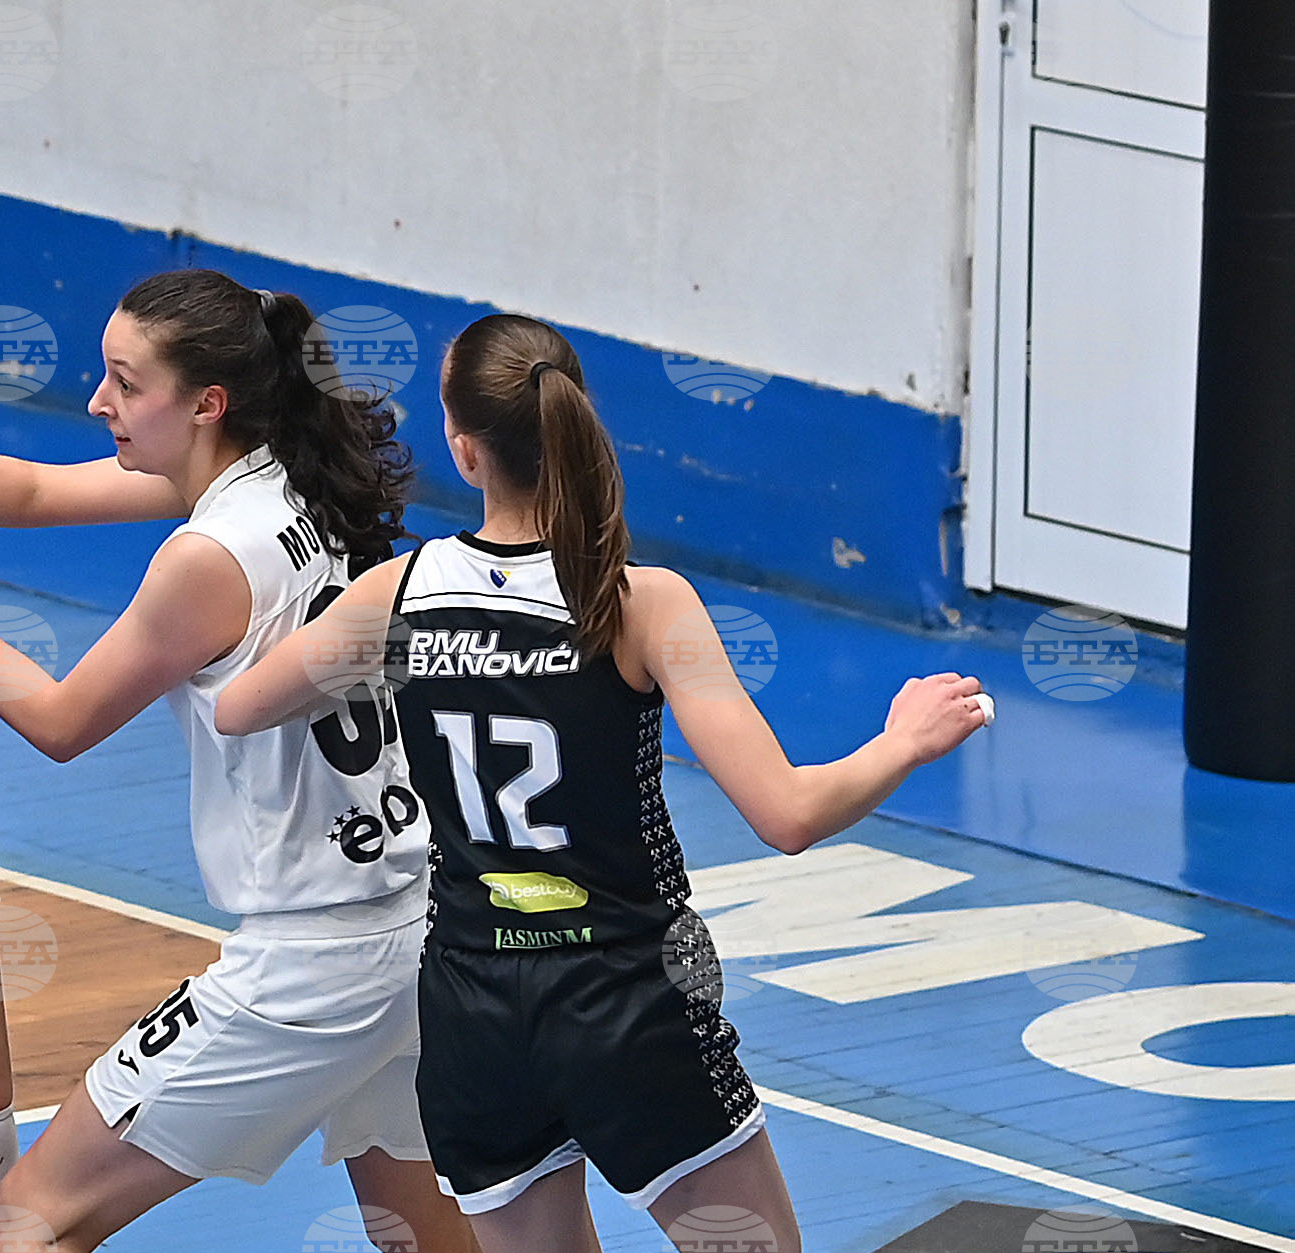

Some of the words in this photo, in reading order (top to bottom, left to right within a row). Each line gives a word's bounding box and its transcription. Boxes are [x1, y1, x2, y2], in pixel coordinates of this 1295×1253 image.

[276, 514, 321, 572] MO
[408, 630, 499, 655] RMU
[431, 710, 570, 851] 12
